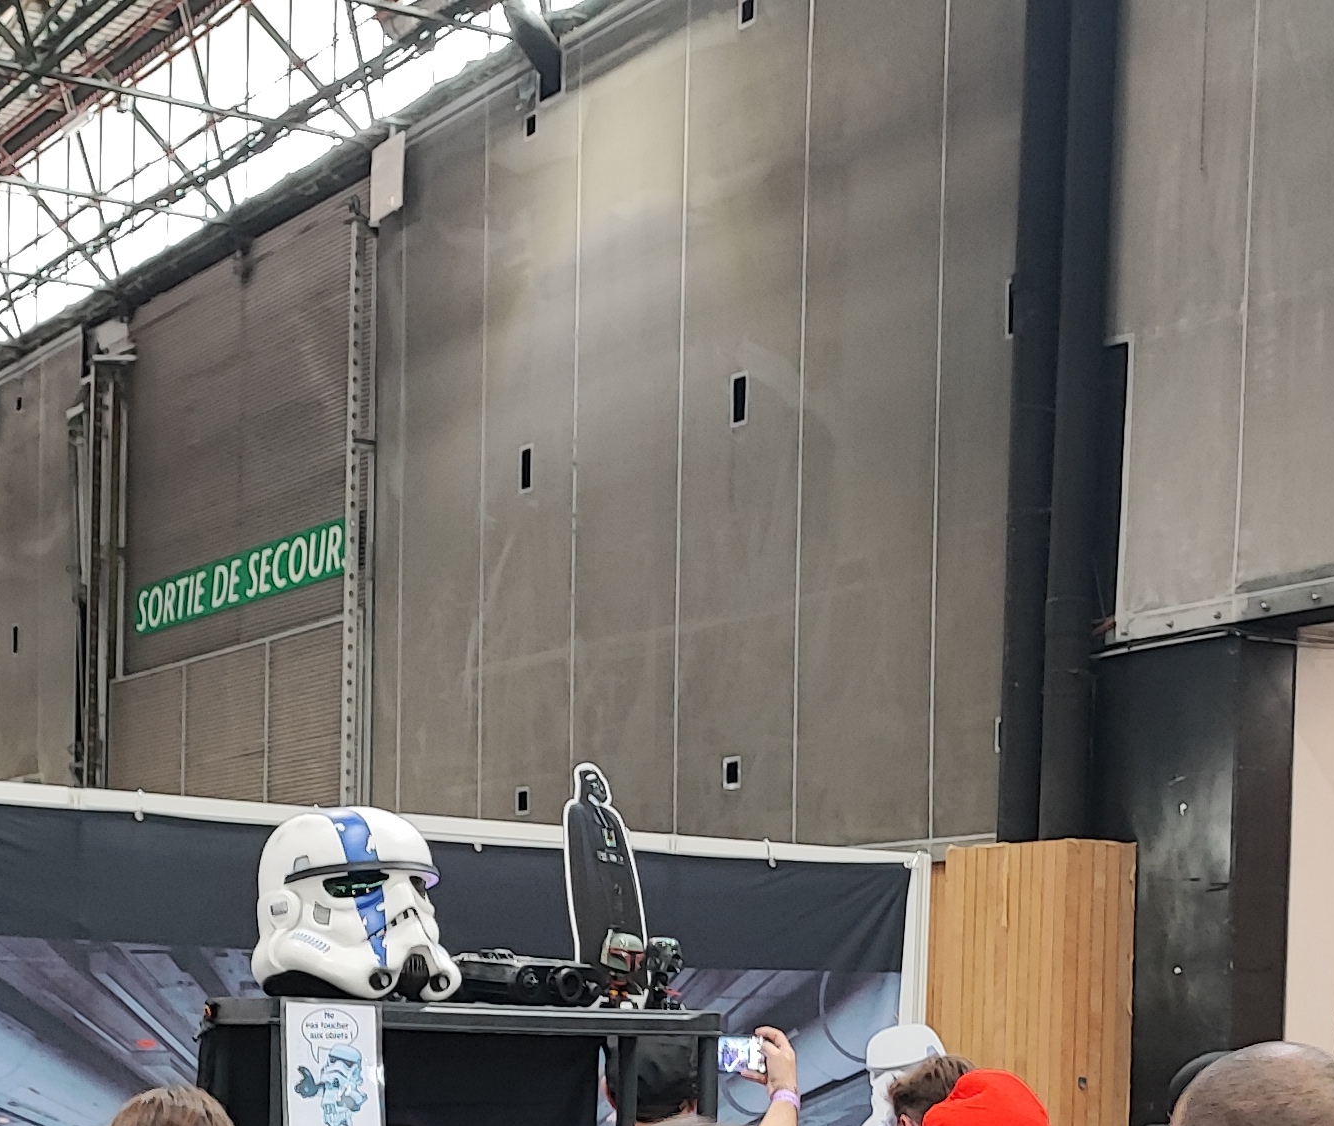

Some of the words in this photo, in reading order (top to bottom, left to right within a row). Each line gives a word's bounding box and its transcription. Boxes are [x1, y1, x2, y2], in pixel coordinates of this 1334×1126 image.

[135, 570, 207, 632] SORTIE
[211, 558, 242, 609] DE
[246, 524, 346, 598] SECOUR
